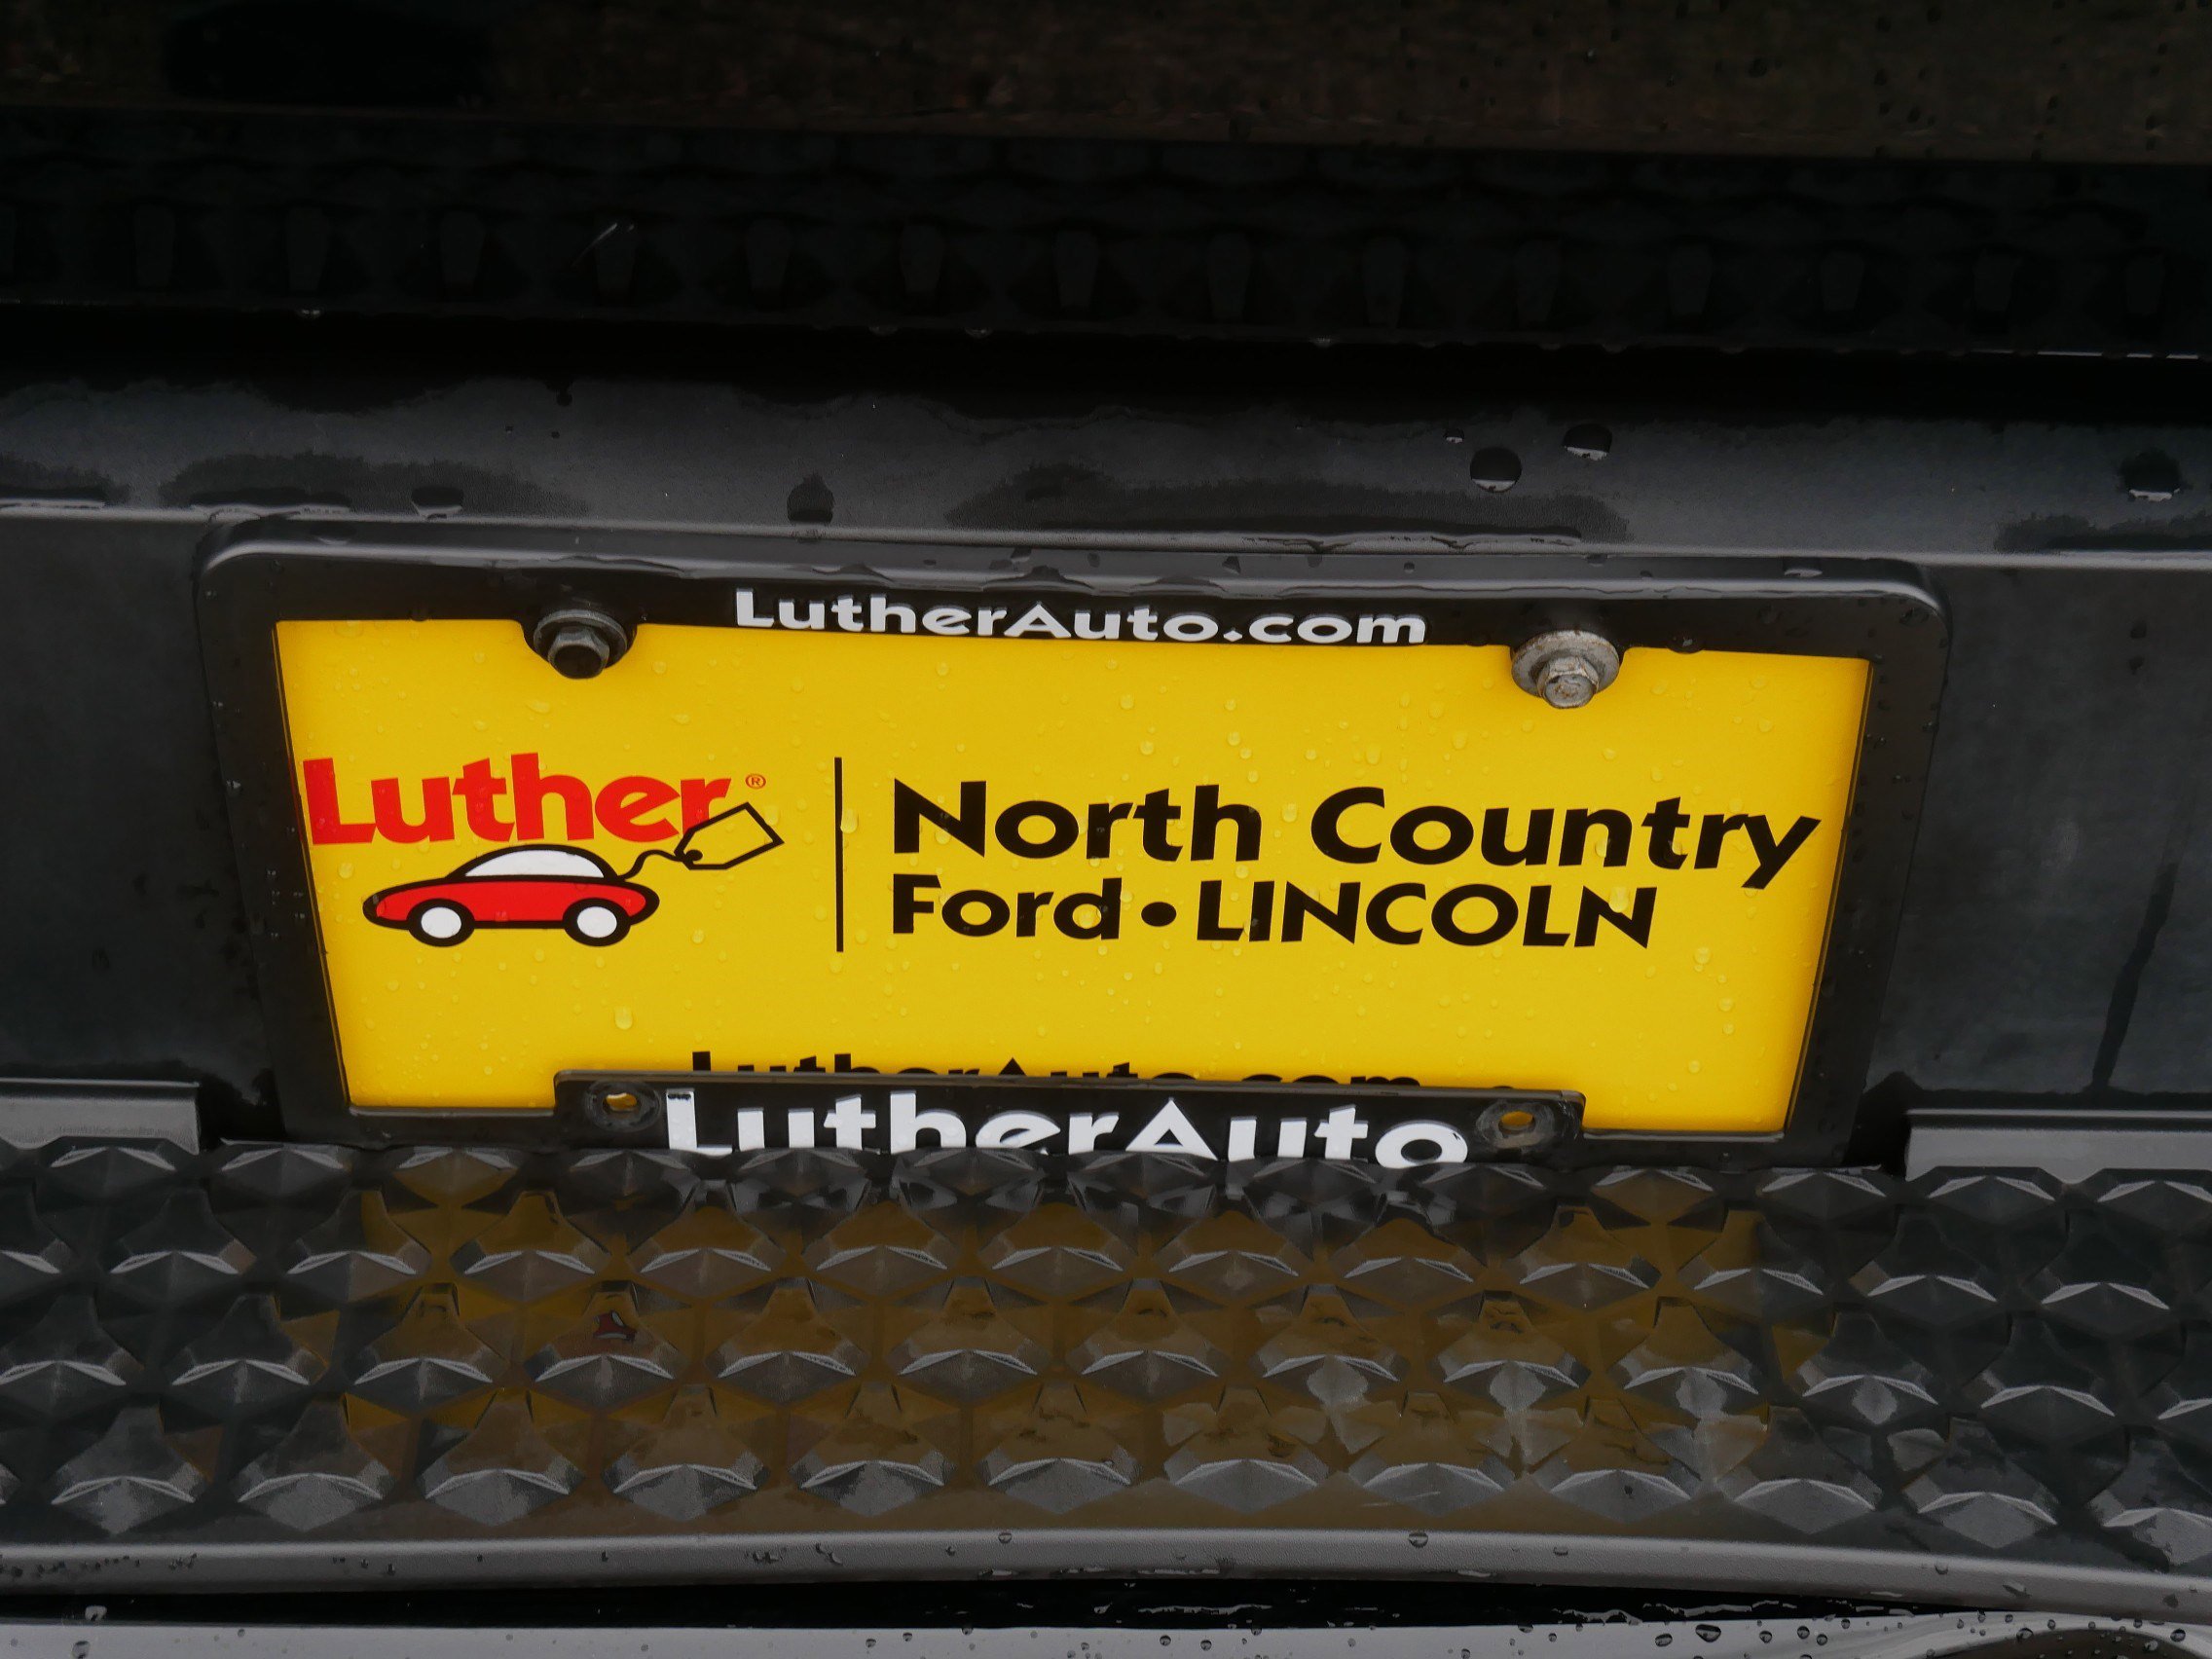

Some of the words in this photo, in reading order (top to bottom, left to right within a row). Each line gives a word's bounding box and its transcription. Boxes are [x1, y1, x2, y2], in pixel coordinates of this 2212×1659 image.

[736, 591, 1426, 644] LutherAuto.com
[895, 779, 1263, 861] North
[1310, 787, 1822, 889] Country
[894, 873, 1123, 940] Ford
[1197, 879, 1658, 949] LINCOLN
[666, 1090, 1468, 1169] LutherAuto
